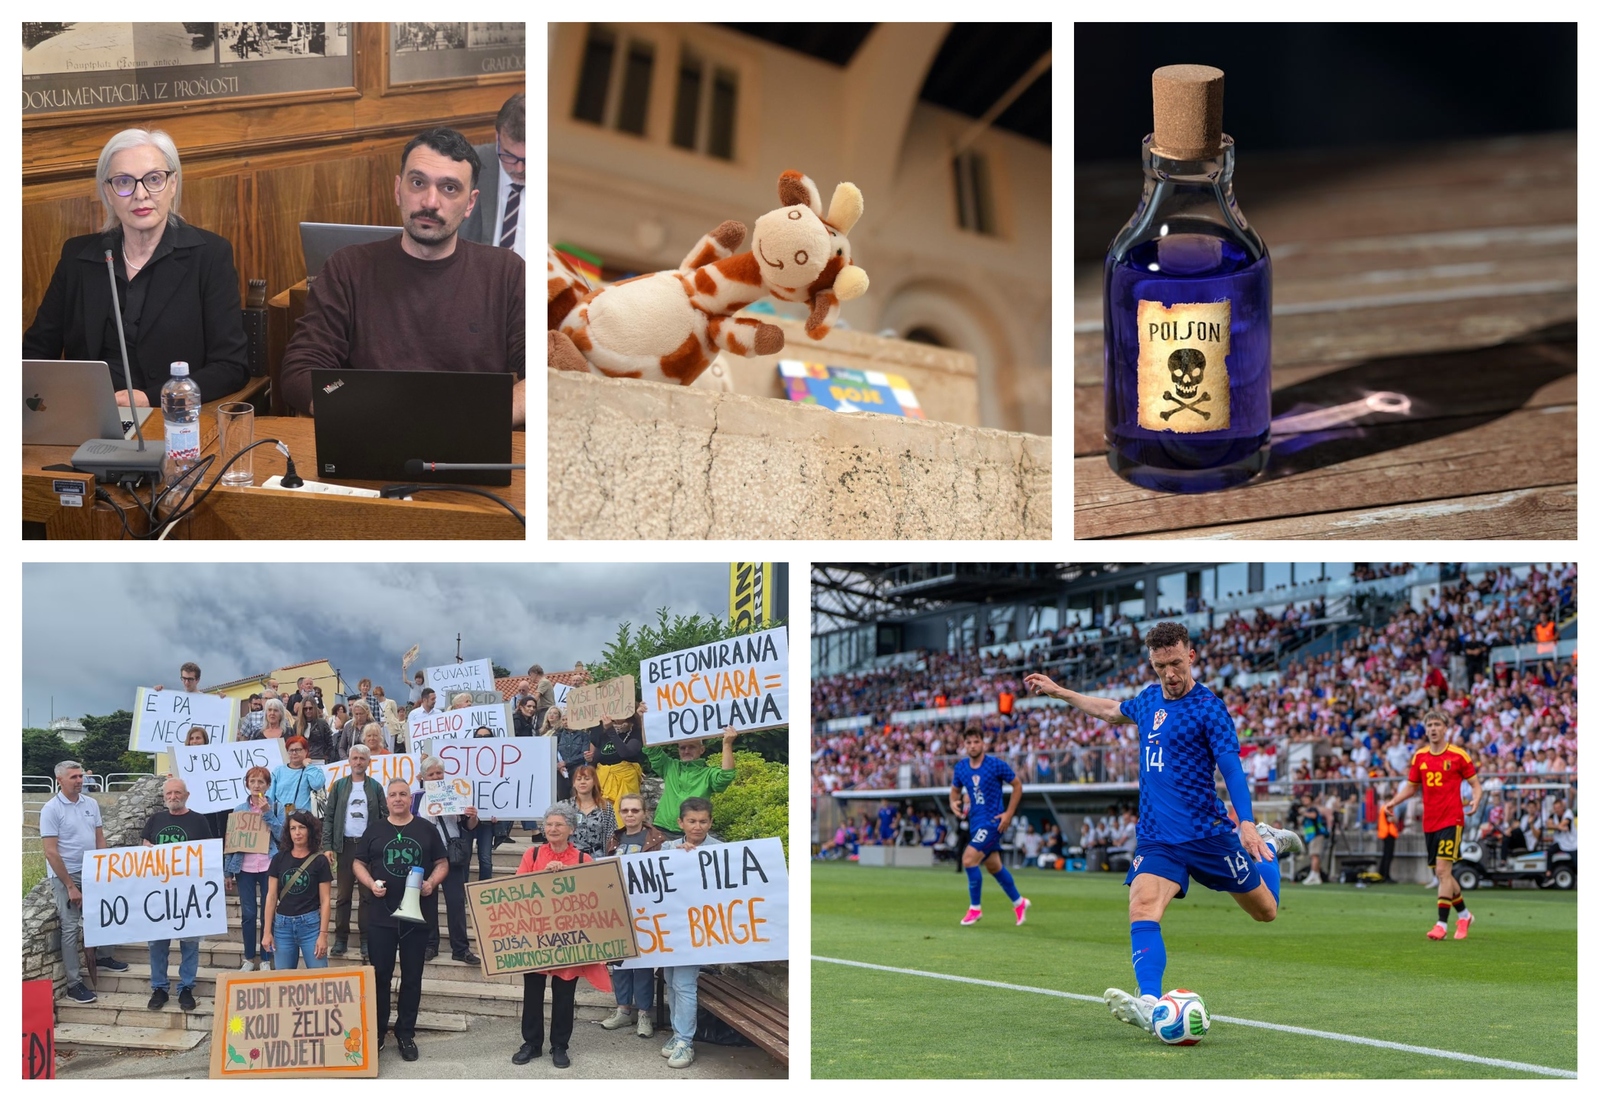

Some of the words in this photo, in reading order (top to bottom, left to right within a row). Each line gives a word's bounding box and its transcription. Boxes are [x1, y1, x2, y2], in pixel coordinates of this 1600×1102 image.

[22, 83, 150, 110] DOKUMENTACIJA
[154, 82, 169, 99] IZ
[174, 76, 239, 97] PROŠLOSTI
[1148, 321, 1221, 342] POISON
[649, 634, 778, 684] BETONIRANA
[433, 668, 482, 681] ČUVAJTE
[656, 666, 761, 711] MOČVARA
[146, 694, 158, 712] E
[173, 695, 191, 715] PA
[570, 690, 592, 705] VIŠE
[412, 714, 463, 738] ZELENO
[471, 710, 498, 727] NIJE
[571, 703, 598, 722] MANJE
[668, 692, 782, 738] POPLAVA
[233, 748, 269, 769] VAS
[439, 744, 522, 778] STOP
[1145, 746, 1165, 773] 14
[328, 755, 415, 793] ZEENO
[1426, 771, 1443, 787] 22
[206, 775, 249, 802] BET
[972, 828, 988, 843] 16
[1438, 839, 1454, 855] 22
[698, 846, 769, 890] PILA
[1224, 851, 1250, 878] 14
[480, 881, 545, 905] STABLA
[551, 876, 576, 895] SU
[101, 895, 129, 928] DO
[486, 900, 543, 922] JAVNO
[551, 891, 599, 914] DOBRO
[554, 908, 625, 931] GRAĐANA
[633, 907, 674, 954] ŠE
[688, 897, 770, 948] BRIGE
[493, 935, 532, 953] DUŠA
[537, 930, 591, 949] KVARTA
[236, 987, 271, 1011] BUDI
[278, 980, 355, 1008] PROMJENA
[245, 1013, 280, 1040] KOJU
[292, 1004, 344, 1038] ŽELIŠ
[264, 1039, 325, 1067] VIDJETI
